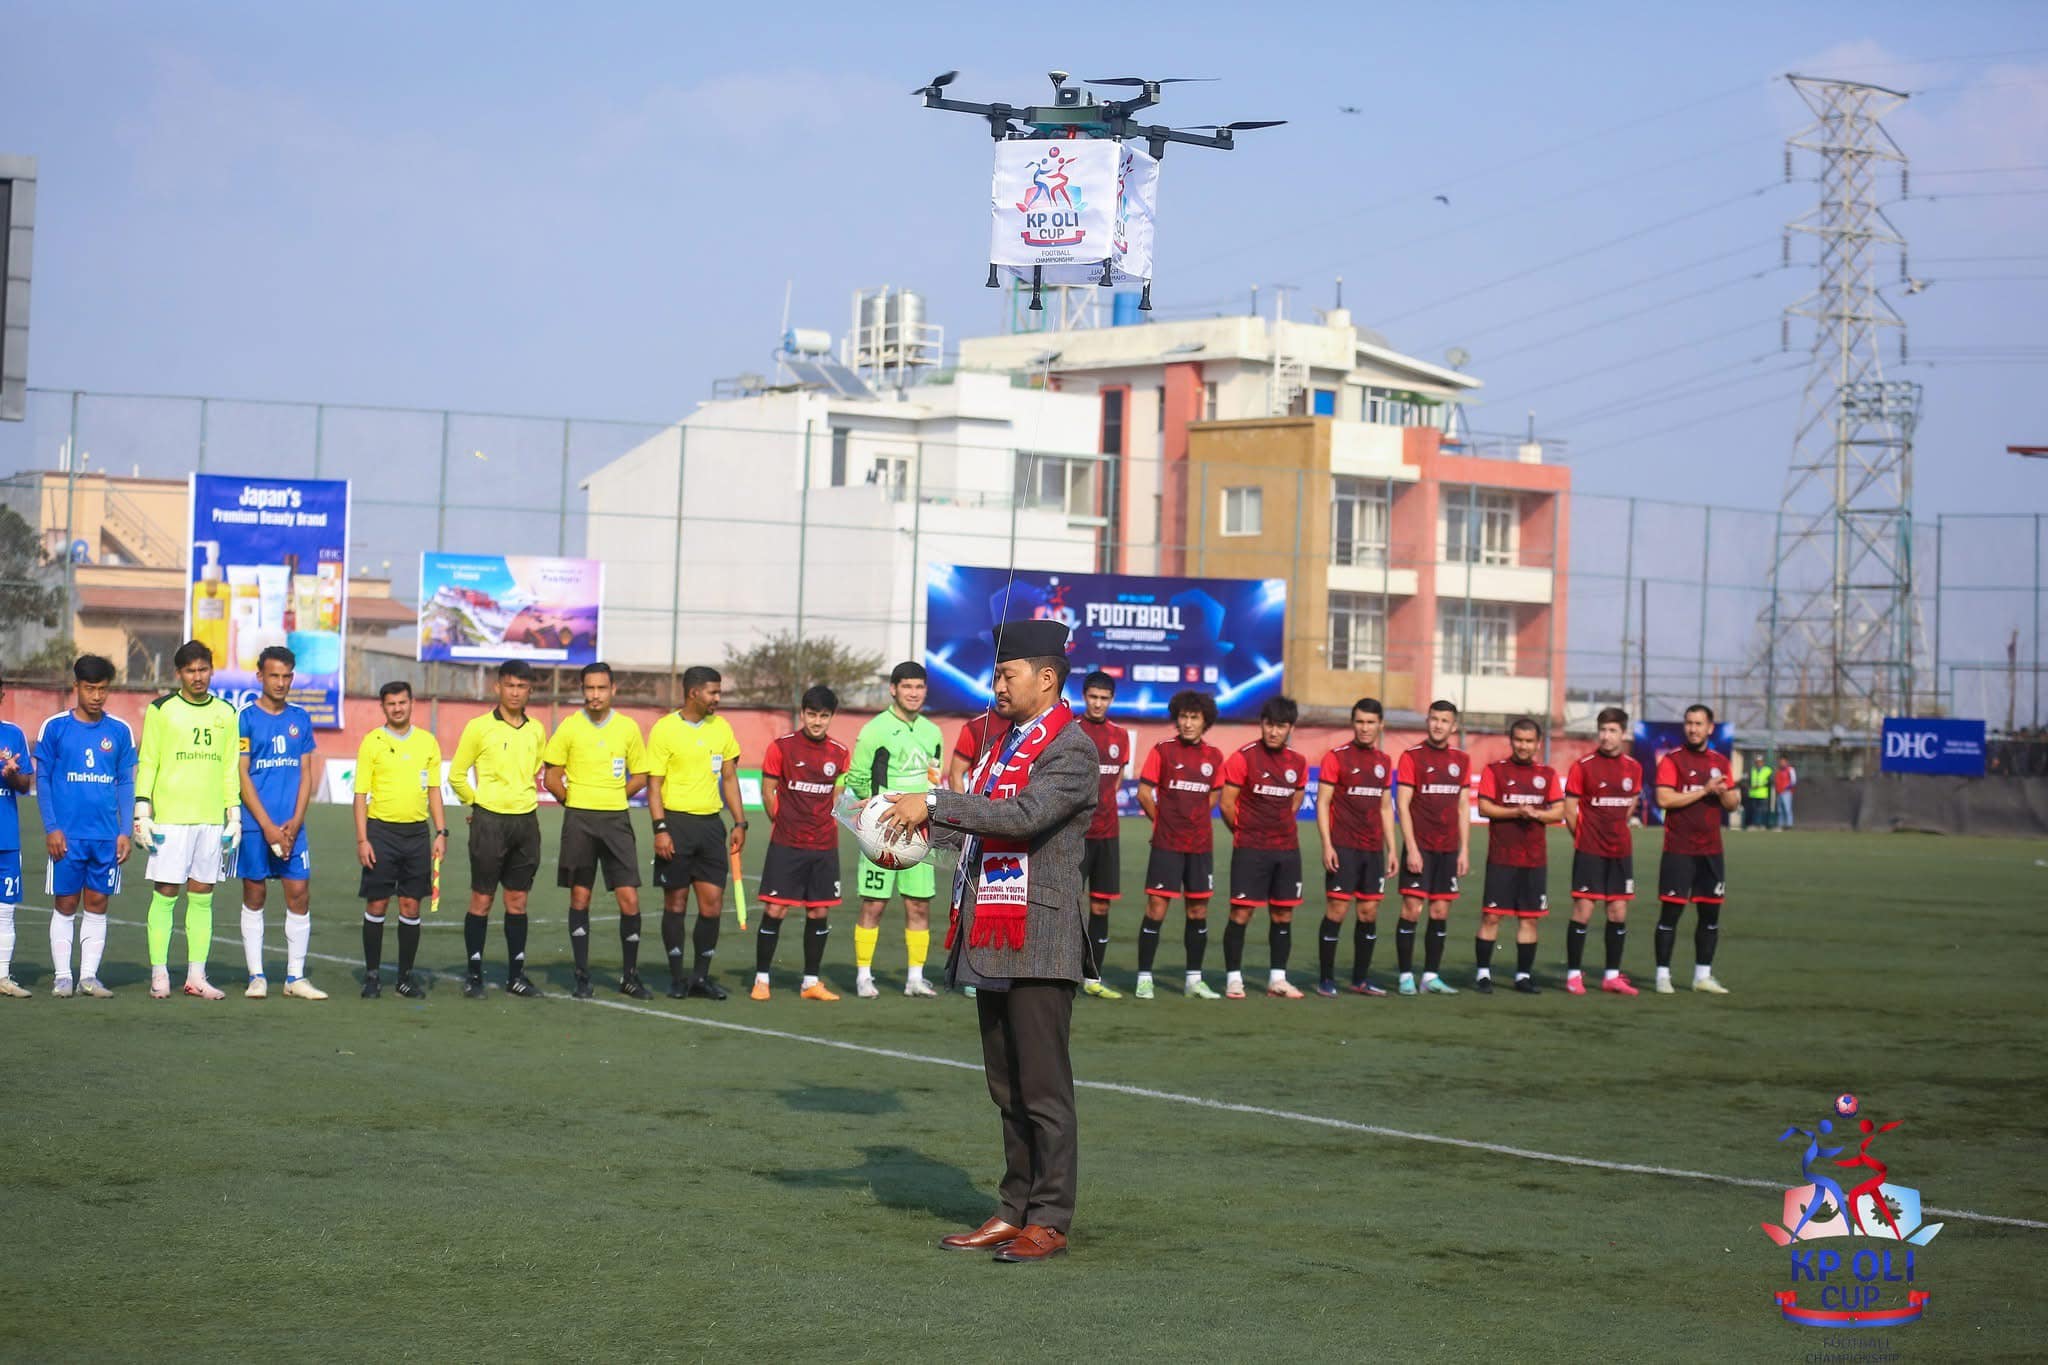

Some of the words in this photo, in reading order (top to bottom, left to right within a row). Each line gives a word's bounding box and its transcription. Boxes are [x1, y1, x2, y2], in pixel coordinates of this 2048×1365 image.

[1026, 212, 1047, 228] KP
[1051, 211, 1079, 228] OLI
[1039, 228, 1065, 240] CUP
[1041, 249, 1072, 257] FOOTBALL
[239, 485, 302, 510] Japan's
[212, 507, 259, 524] Premium
[1085, 602, 1185, 631] FOOTBALL
[193, 727, 212, 746] 25
[271, 734, 286, 754] 10
[1886, 731, 1938, 760] DHC
[84, 748, 95, 769] 3
[4, 876, 20, 896] 21
[108, 868, 116, 888] 3
[865, 870, 885, 891] 25
